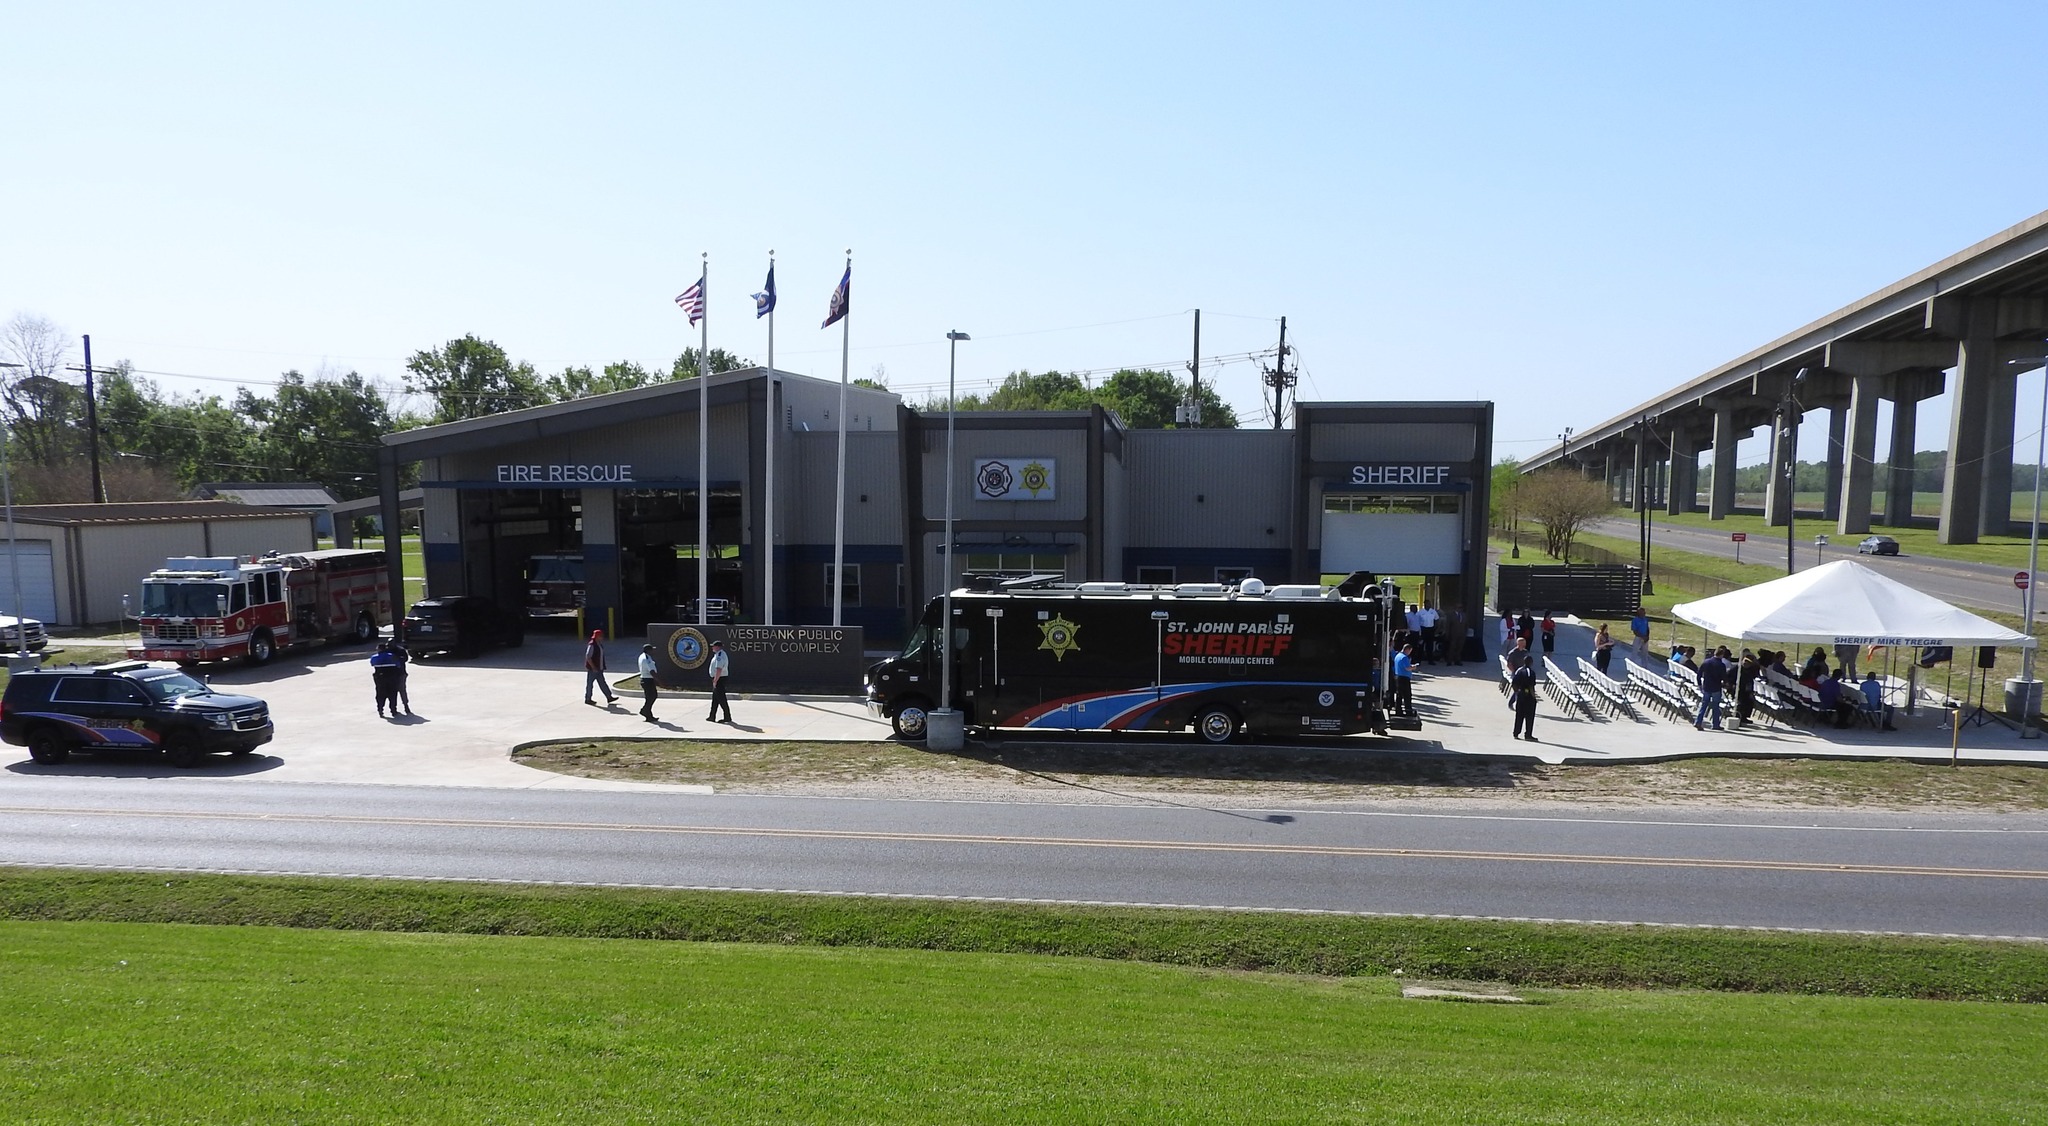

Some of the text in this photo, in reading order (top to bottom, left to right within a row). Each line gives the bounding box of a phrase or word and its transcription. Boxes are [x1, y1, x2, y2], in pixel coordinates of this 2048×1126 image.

[497, 465, 632, 482] FIRE RESCUE
[1352, 466, 1450, 484] SHERIFF
[1167, 621, 1189, 633] ST.
[1193, 622, 1234, 634] JOHN
[726, 628, 843, 641] WESTBANK PUBLIC
[1833, 636, 1944, 646] SHERIFF MIKE TREGRE
[729, 641, 840, 653] SAFETY COMPLEX
[1162, 633, 1293, 656] SHERIFF
[1178, 656, 1275, 666] MOBILE COMMAND CENTER
[86, 718, 129, 728] SHERIFF
